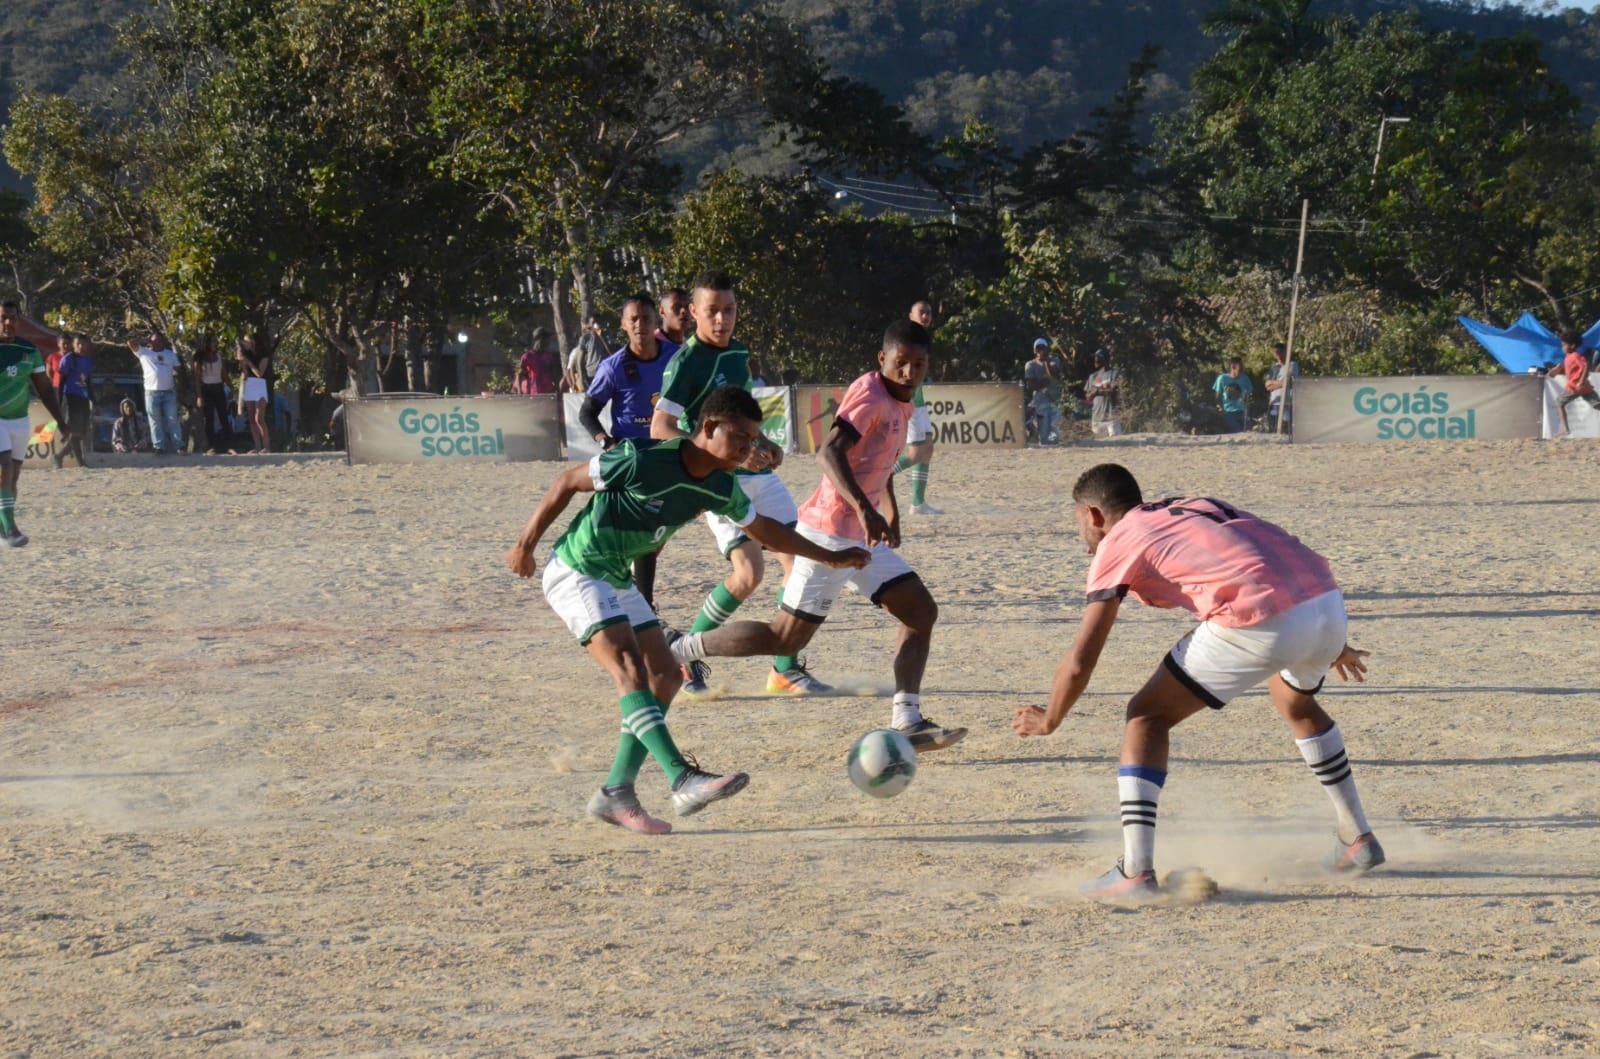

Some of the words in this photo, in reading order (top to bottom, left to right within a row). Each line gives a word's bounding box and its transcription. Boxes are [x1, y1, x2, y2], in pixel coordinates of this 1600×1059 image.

[925, 400, 966, 416] COPA
[1353, 385, 1449, 415] Goiás
[398, 406, 480, 434] Goiás
[1376, 408, 1476, 440] social
[420, 428, 505, 457] social
